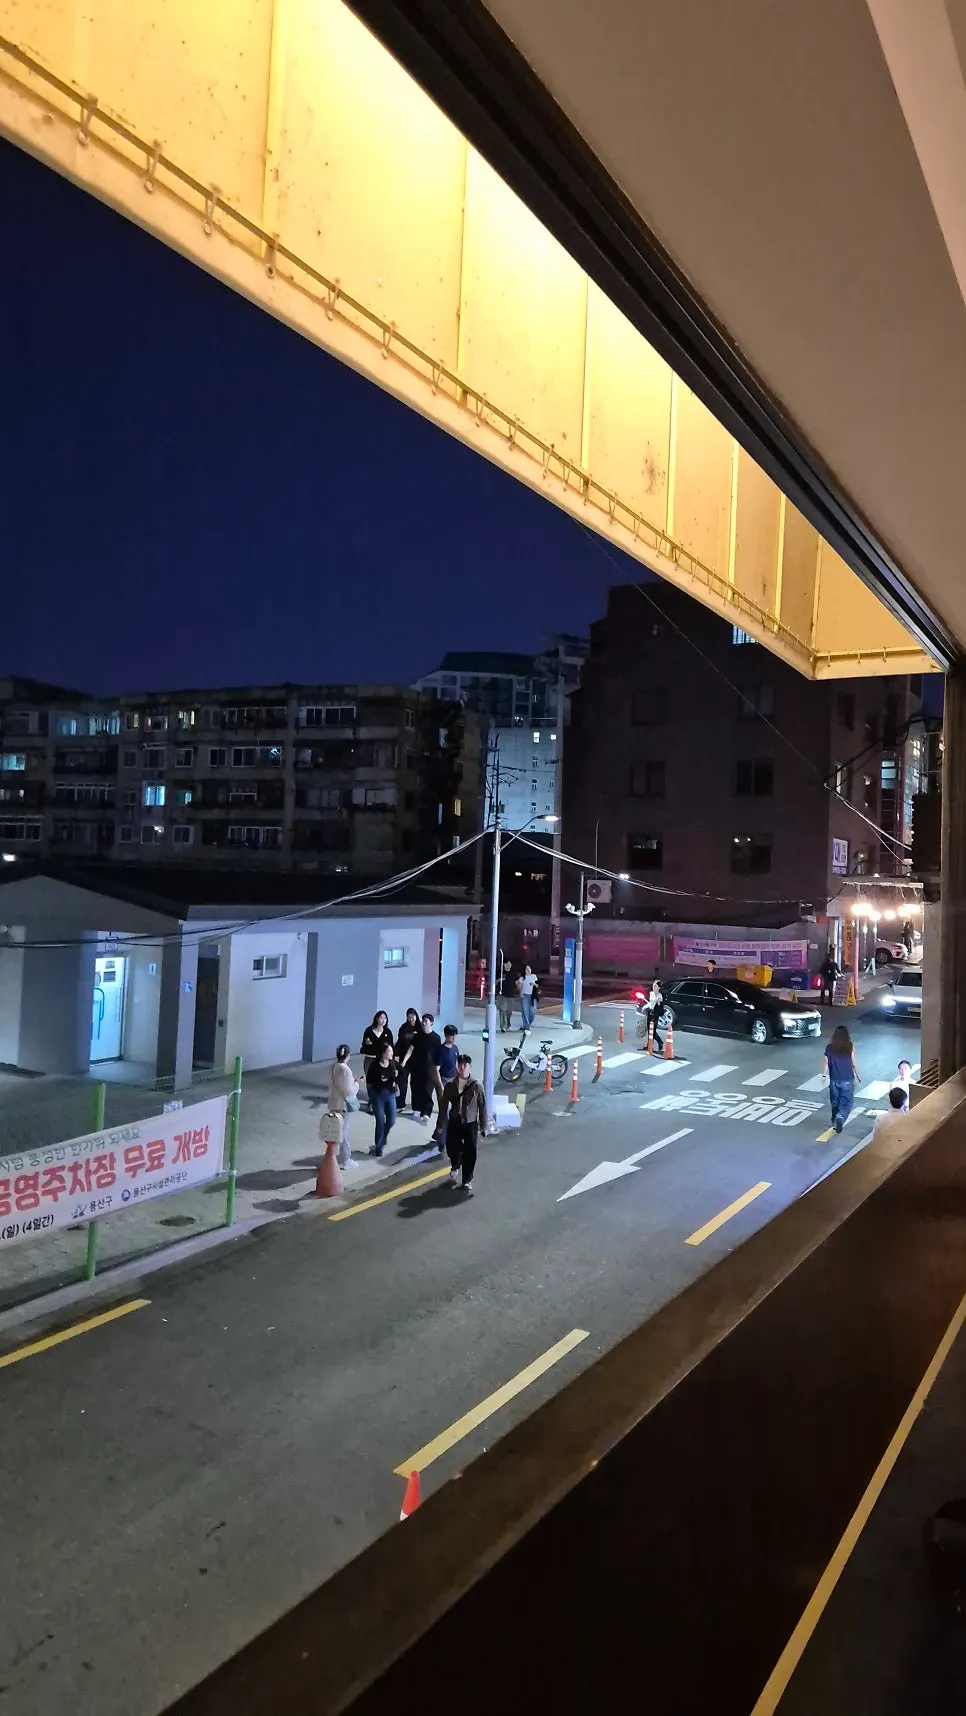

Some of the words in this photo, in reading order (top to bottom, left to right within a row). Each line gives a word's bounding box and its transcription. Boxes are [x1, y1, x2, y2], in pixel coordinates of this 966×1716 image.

[639, 1090, 825, 1127] 일방통행
[29, 1147, 66, 1166] 풍성한
[69, 1138, 105, 1157] 한가위
[124, 1140, 166, 1179] 무료
[172, 1125, 209, 1164] 개방
[90, 1196, 113, 1213] 용산구
[133, 1171, 188, 1198] 용산구시설관리공단
[22, 1214, 54, 1234] (4일간)
